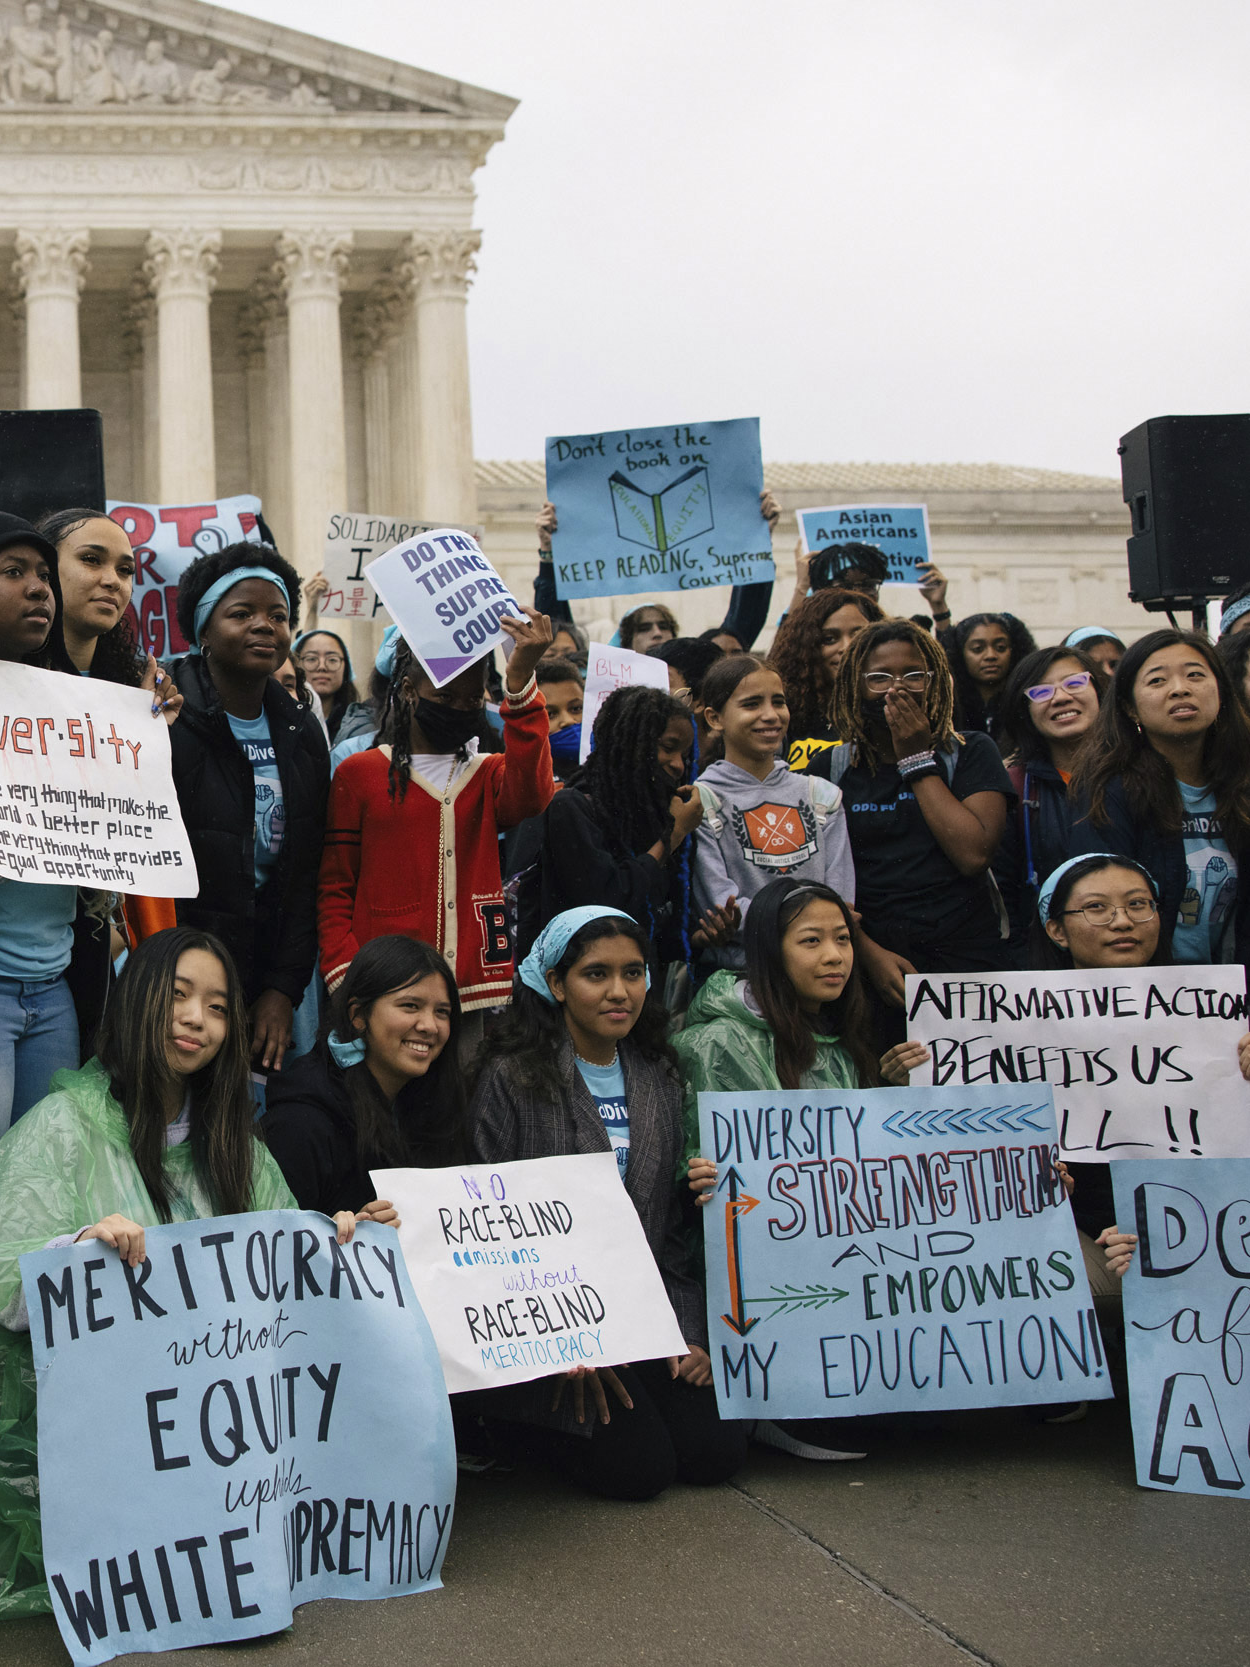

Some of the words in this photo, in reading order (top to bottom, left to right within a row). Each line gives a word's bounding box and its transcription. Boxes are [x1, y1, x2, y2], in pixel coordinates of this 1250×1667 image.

[9, 163, 102, 185] UNDER
[550, 436, 606, 462] Don't
[617, 433, 663, 453] close
[673, 427, 711, 448] the
[626, 452, 671, 472] book
[679, 453, 709, 465] on
[109, 505, 218, 547] OT
[816, 525, 918, 541] Americans
[839, 510, 893, 525] Asian
[401, 541, 436, 573] DO
[559, 559, 606, 583] KEEP
[617, 548, 703, 578] READING,
[708, 546, 773, 577] Supreme
[320, 587, 369, 616] 力量
[435, 577, 510, 627] SUPRE
[596, 658, 632, 679] BLM
[7, 784, 39, 807] very
[41, 784, 77, 812] thing
[78, 789, 106, 809] that
[107, 797, 145, 816] makes
[146, 800, 173, 820] the
[26, 813, 38, 827] a
[41, 810, 100, 836] better
[106, 820, 153, 840] place
[12, 833, 46, 854] very
[44, 837, 81, 861] thing
[79, 842, 111, 862] that
[113, 850, 183, 867] provides
[908, 978, 1139, 1023] AFFIRMATIVE
[1145, 984, 1250, 1022] ACTION
[927, 1035, 1118, 1088] BENEFITS
[1132, 1045, 1194, 1085] US
[712, 1106, 865, 1165] DIVERSITY
[1060, 1109, 1154, 1151] LL
[461, 1173, 506, 1201] NO
[438, 1200, 573, 1245] RACE-BLIND
[453, 1246, 540, 1267] admissions
[832, 1231, 975, 1268] AND
[36, 1229, 405, 1349] MERITOCRACY
[503, 1264, 583, 1292] without
[862, 1250, 1075, 1321] EMPOWERS
[464, 1284, 606, 1344] RACE-BLIND
[481, 1329, 605, 1369] MERITOCRACY
[721, 1342, 778, 1401] MY
[819, 1309, 1106, 1399] EDUCATION!
[145, 1362, 342, 1472] EQUITY
[50, 1526, 262, 1653] WHITE
[282, 1497, 451, 1593] UPREMACY
